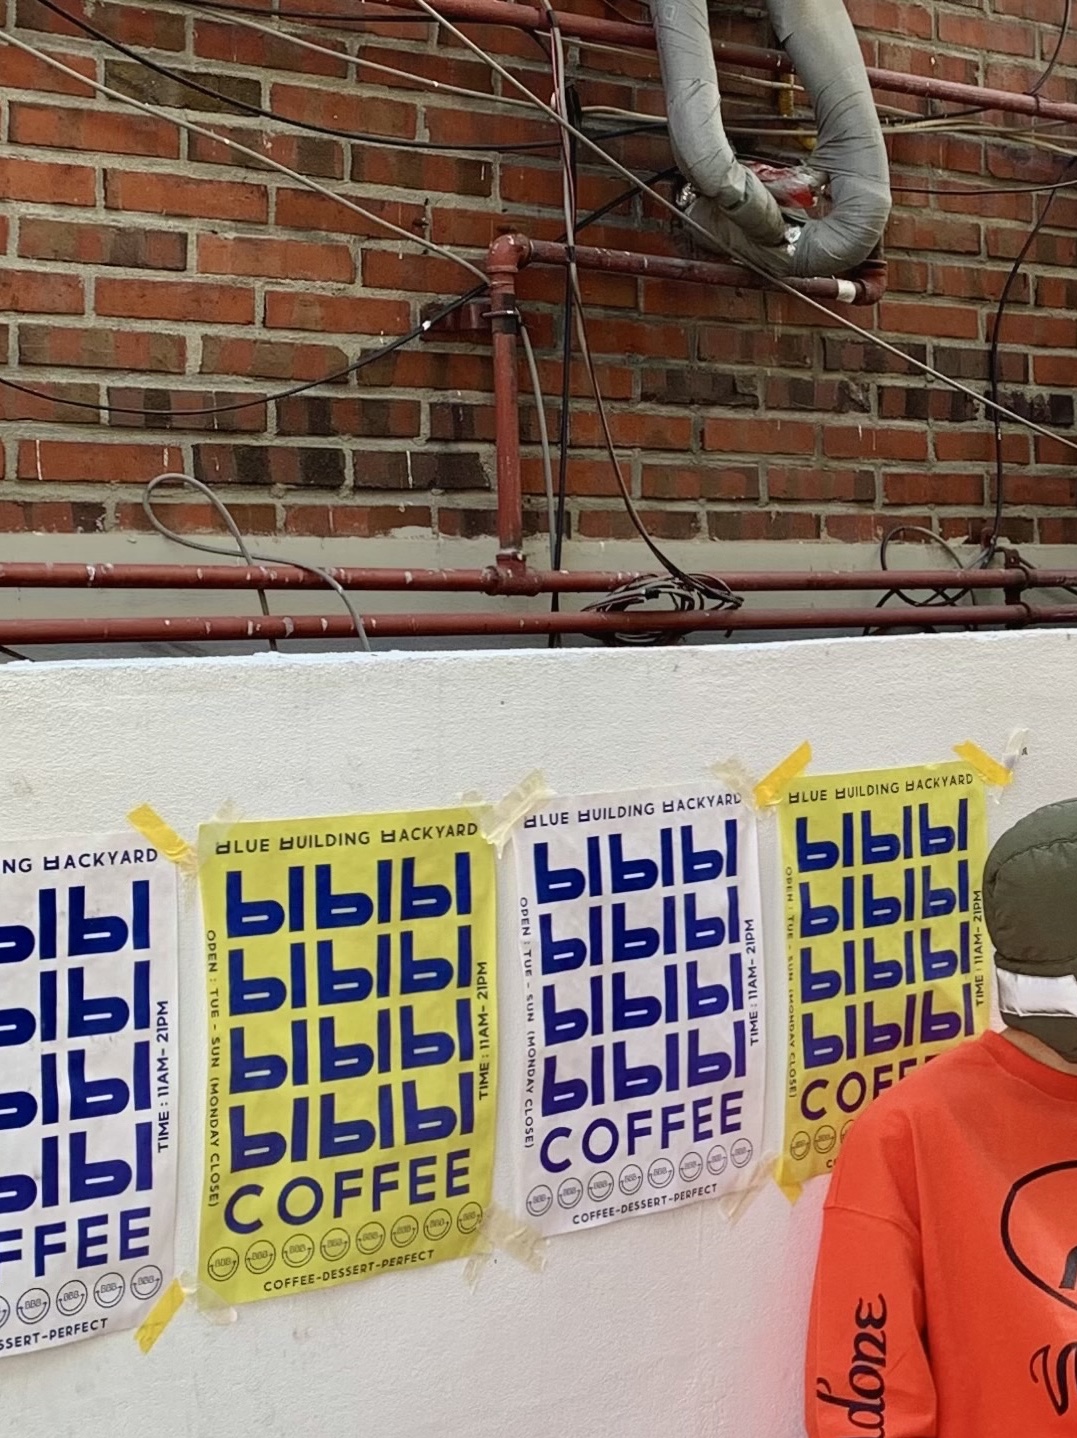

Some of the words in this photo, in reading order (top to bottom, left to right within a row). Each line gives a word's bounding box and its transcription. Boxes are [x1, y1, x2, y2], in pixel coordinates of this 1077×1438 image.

[523, 812, 569, 829] BLUE
[578, 802, 655, 823] BUILDING
[215, 838, 270, 855] BLUE
[279, 831, 370, 850] BUILDING
[381, 822, 478, 844] BACKYARD
[519, 897, 531, 937] OPEN
[744, 919, 756, 954] 21PM
[207, 929, 218, 973] OPEN
[523, 948, 533, 977] TUE
[476, 961, 488, 1000] 21PM
[974, 975, 984, 1007] TIME
[157, 1000, 169, 1043] 21PM
[209, 987, 219, 1018] TUE
[526, 993, 534, 1022] SUN
[748, 1010, 759, 1046] TIME
[210, 1037, 220, 1068] SUN
[525, 1030, 536, 1094] (MONDAY
[478, 1062, 490, 1101] TIME
[209, 1077, 220, 1147] (MONDAY
[524, 1098, 534, 1148] CLOSE)
[158, 1111, 170, 1153] TIME
[539, 1090, 744, 1174] COFFEE
[208, 1152, 220, 1207] CLOSE)
[223, 1148, 471, 1235] COFFEE
[263, 1249, 434, 1292] COFFEE-DESSERT-PERFECT
